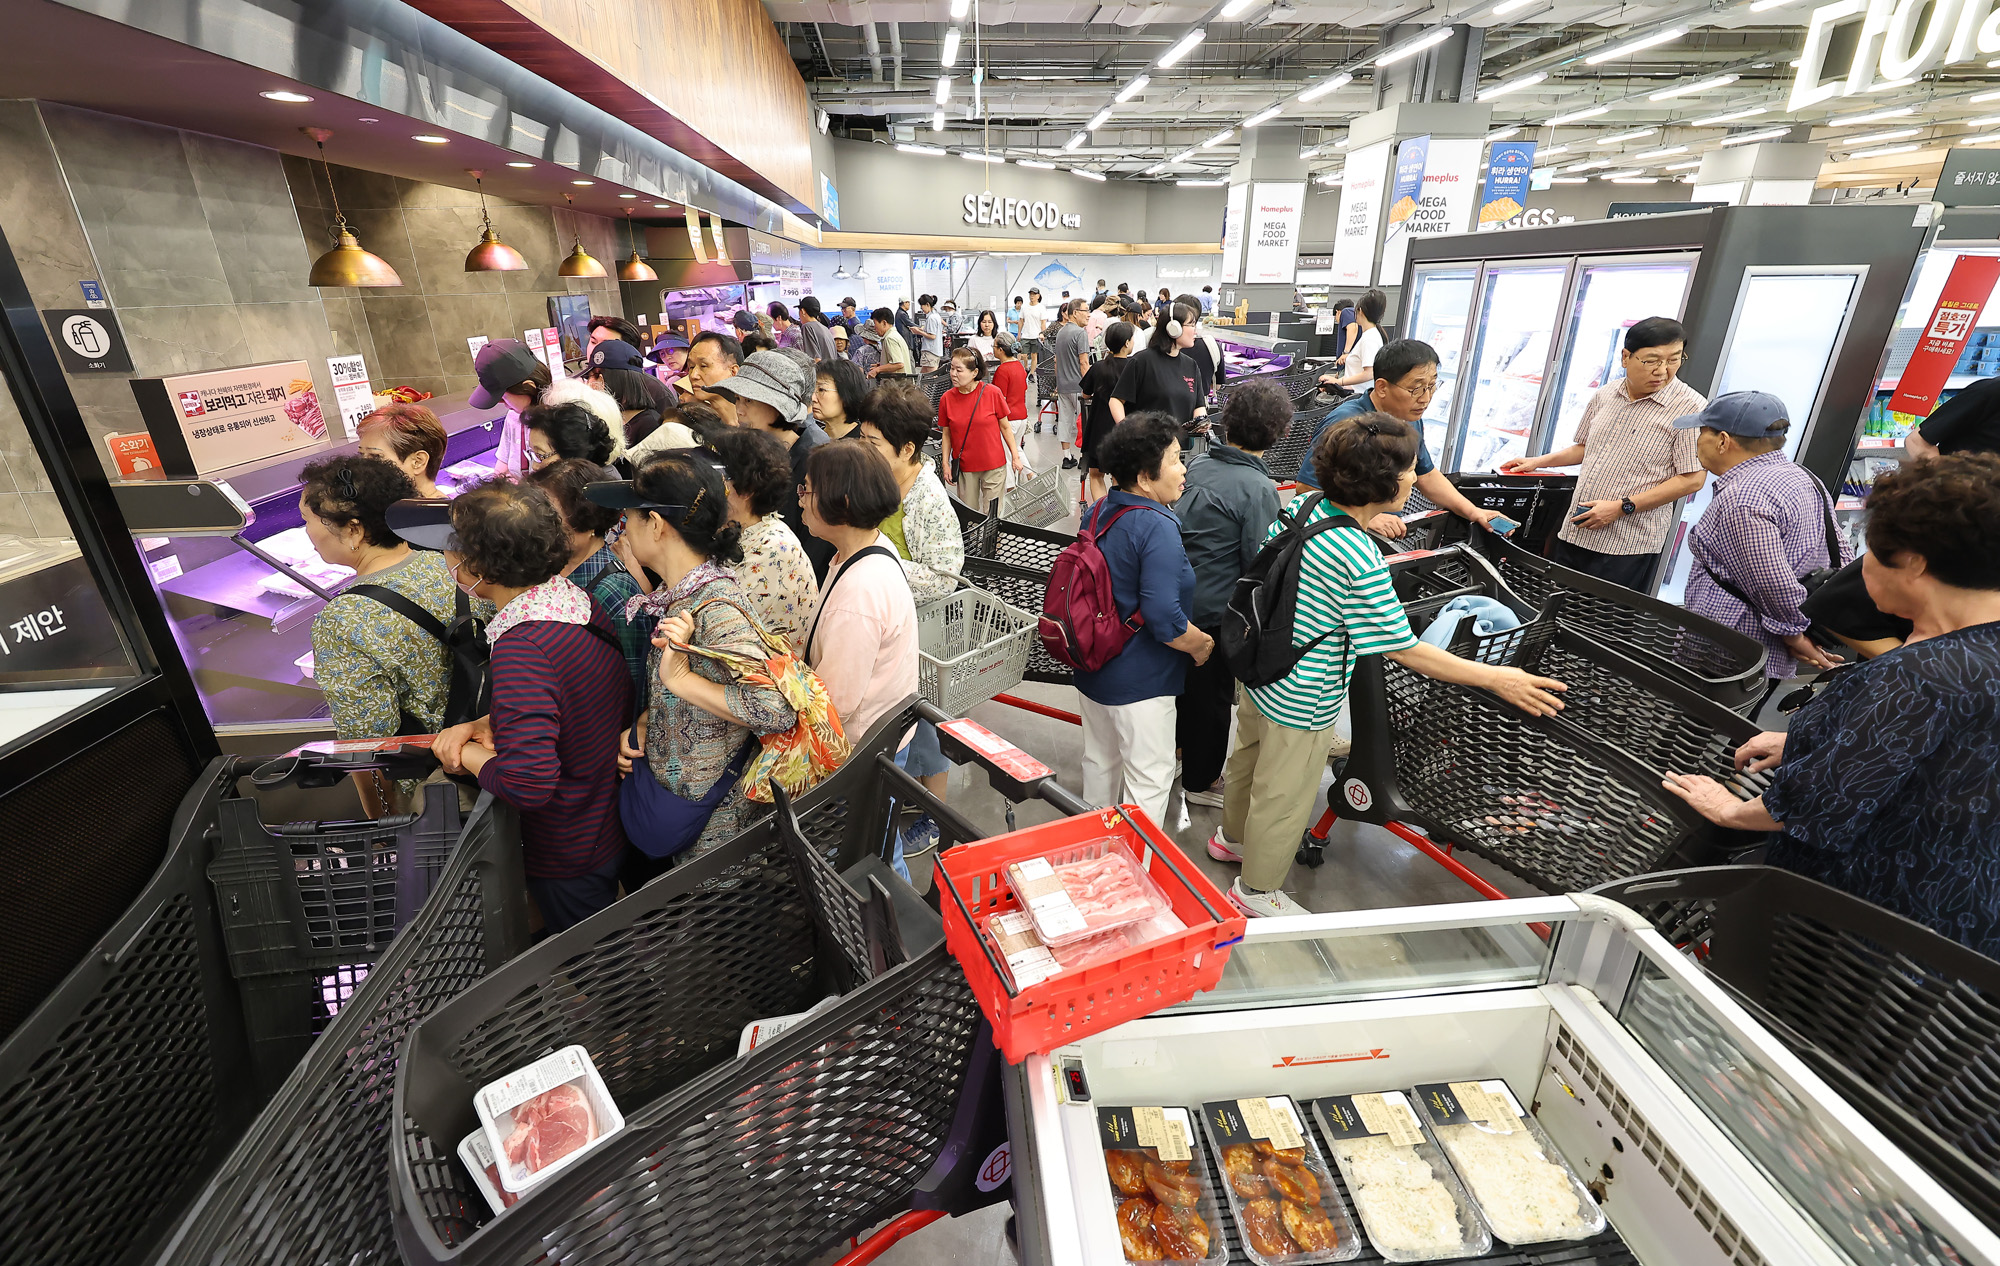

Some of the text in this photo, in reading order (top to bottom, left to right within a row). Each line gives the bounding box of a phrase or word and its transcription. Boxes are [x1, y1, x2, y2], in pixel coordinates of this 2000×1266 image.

[1506, 166, 1529, 176] 생연어
[1421, 173, 1459, 184] omeplus
[1494, 176, 1522, 184] HURRA!
[1954, 171, 2000, 186] 줄서지 않
[1350, 179, 1375, 190] Homeplus
[1418, 196, 1447, 207] MEGA
[962, 193, 1060, 229] SEAFOOD
[1260, 205, 1293, 213] Homeplus
[1351, 202, 1368, 213] MEGA
[1349, 214, 1367, 225] FOOD
[1413, 209, 1446, 220] FOOD
[1503, 208, 1556, 229] GGS
[1263, 222, 1286, 230] MEGA
[1344, 225, 1368, 237] MARKET
[1405, 222, 1451, 233] MARKET
[1262, 230, 1286, 238] FOOD
[1257, 239, 1290, 247] MARKET
[877, 276, 904, 284] SEAFOOD
[1941, 300, 1960, 308] 품질은
[1940, 311, 1971, 323] 절호의
[1934, 321, 1966, 337] 특가
[1922, 345, 1955, 355] 구매하세요!
[332, 361, 363, 376] 30%할인
[201, 388, 217, 397] 캐나다
[217, 385, 233, 394] 천혜의
[205, 393, 248, 413] 보리먹고
[248, 389, 267, 405] 자란
[266, 386, 287, 402] 돼지
[192, 414, 277, 439] 냉장상태로 유통되어 신선하고
[119, 438, 149, 452] 소화기
[9, 604, 67, 644] 제안
[1111, 1114, 1119, 1131] CHOICE
